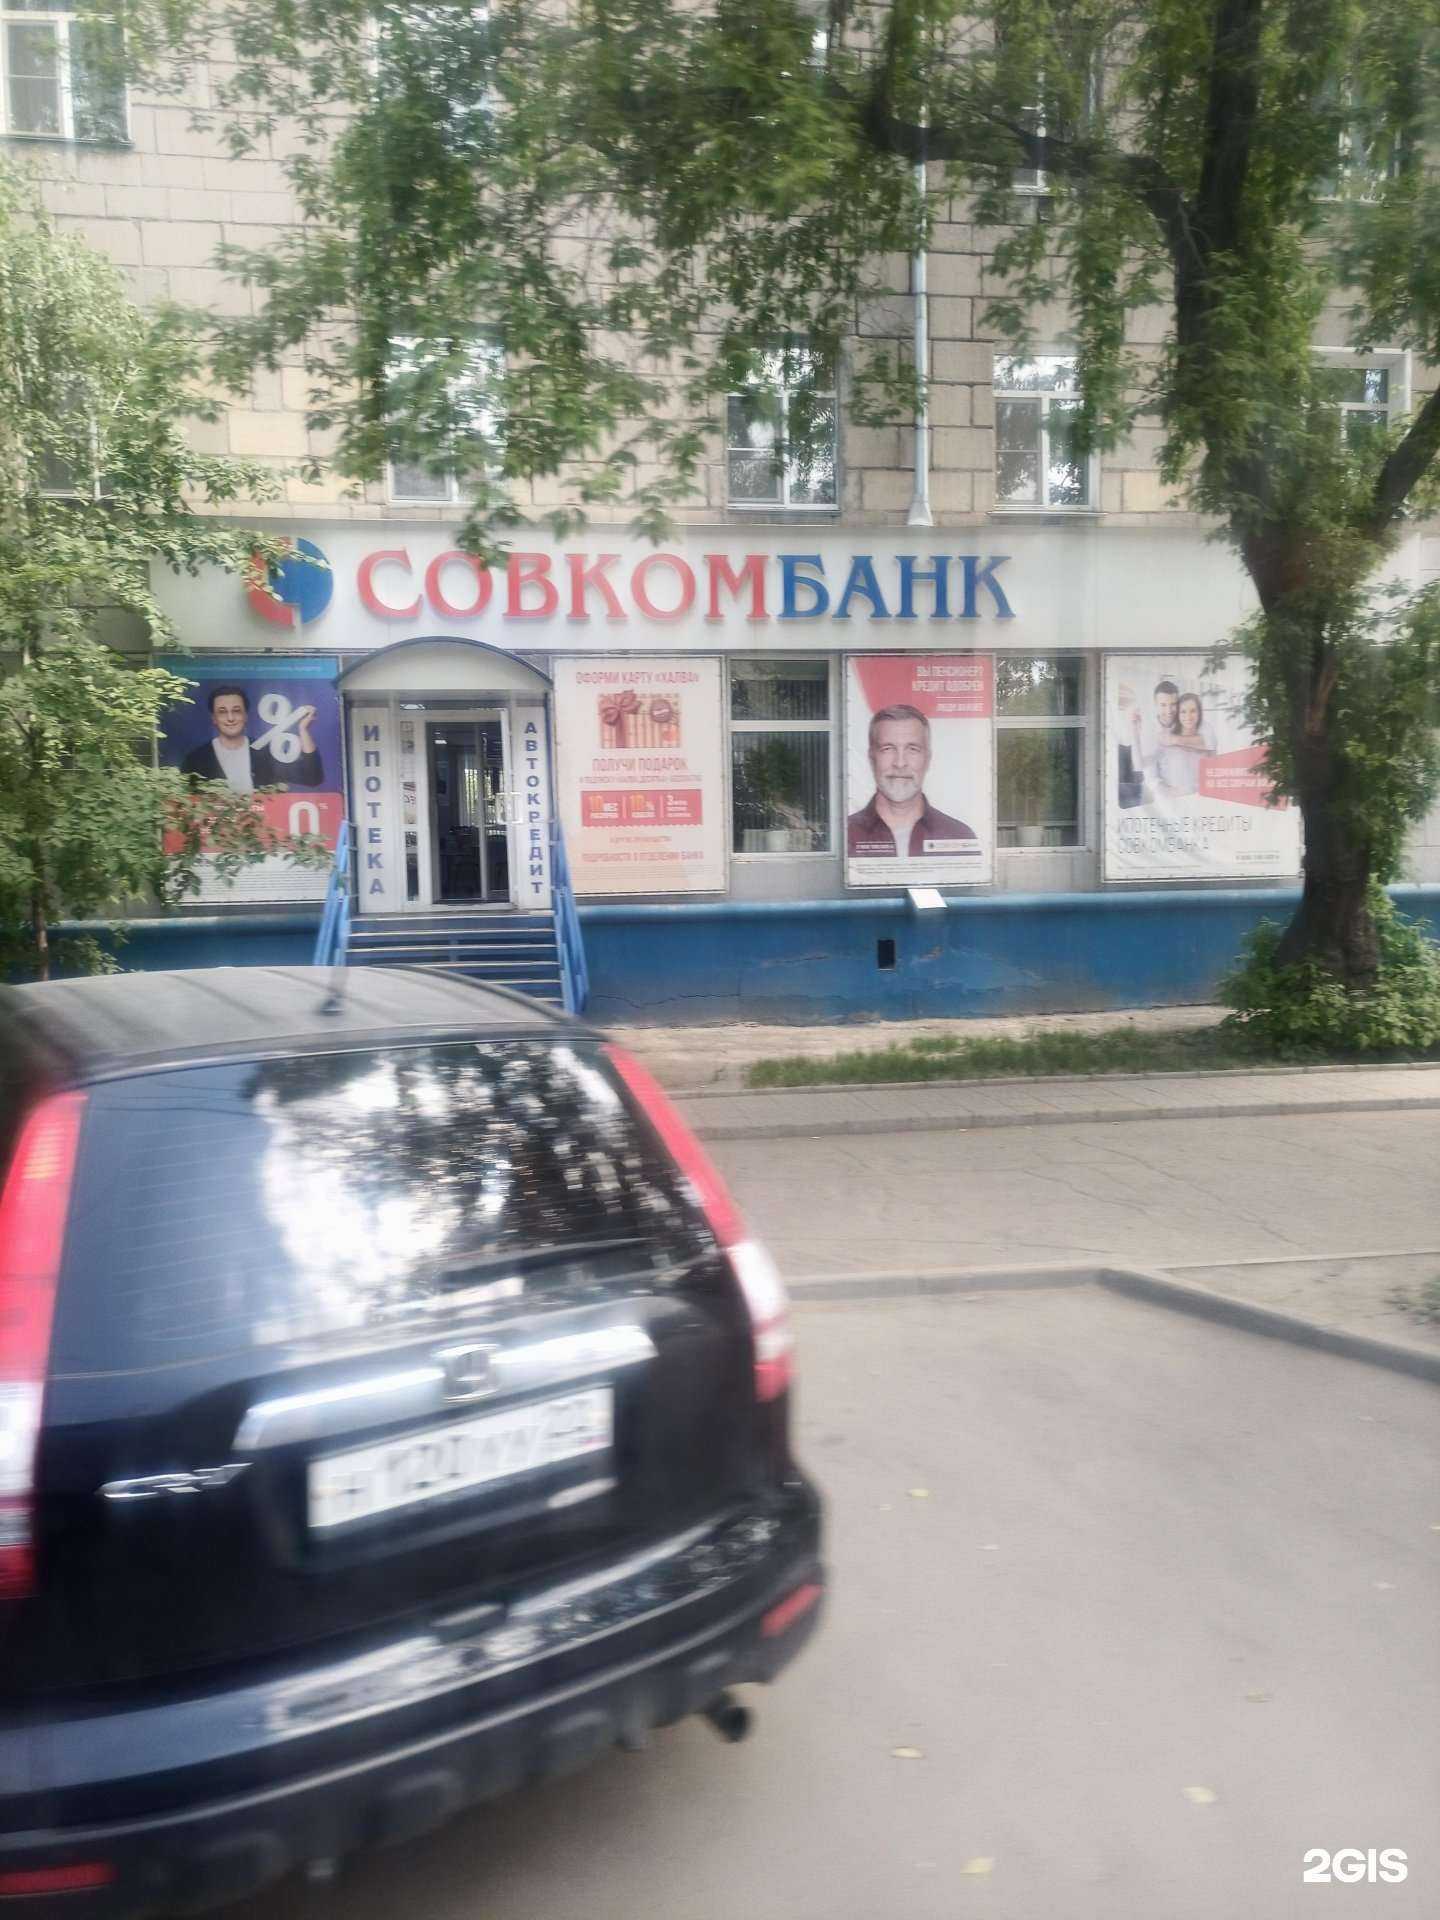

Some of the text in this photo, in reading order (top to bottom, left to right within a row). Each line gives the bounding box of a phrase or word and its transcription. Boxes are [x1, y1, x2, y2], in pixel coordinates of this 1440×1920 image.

[356, 547, 1016, 622] СОВКОМБАНК
[575, 671, 620, 685] ОФОРМИ
[621, 671, 652, 684] КАРТУ
[592, 757, 688, 772] ПОЛУЧИ ПОДАРОК
[362, 724, 385, 895] ИПОТЕКА
[523, 721, 544, 894] АВТОКРЕДИТ
